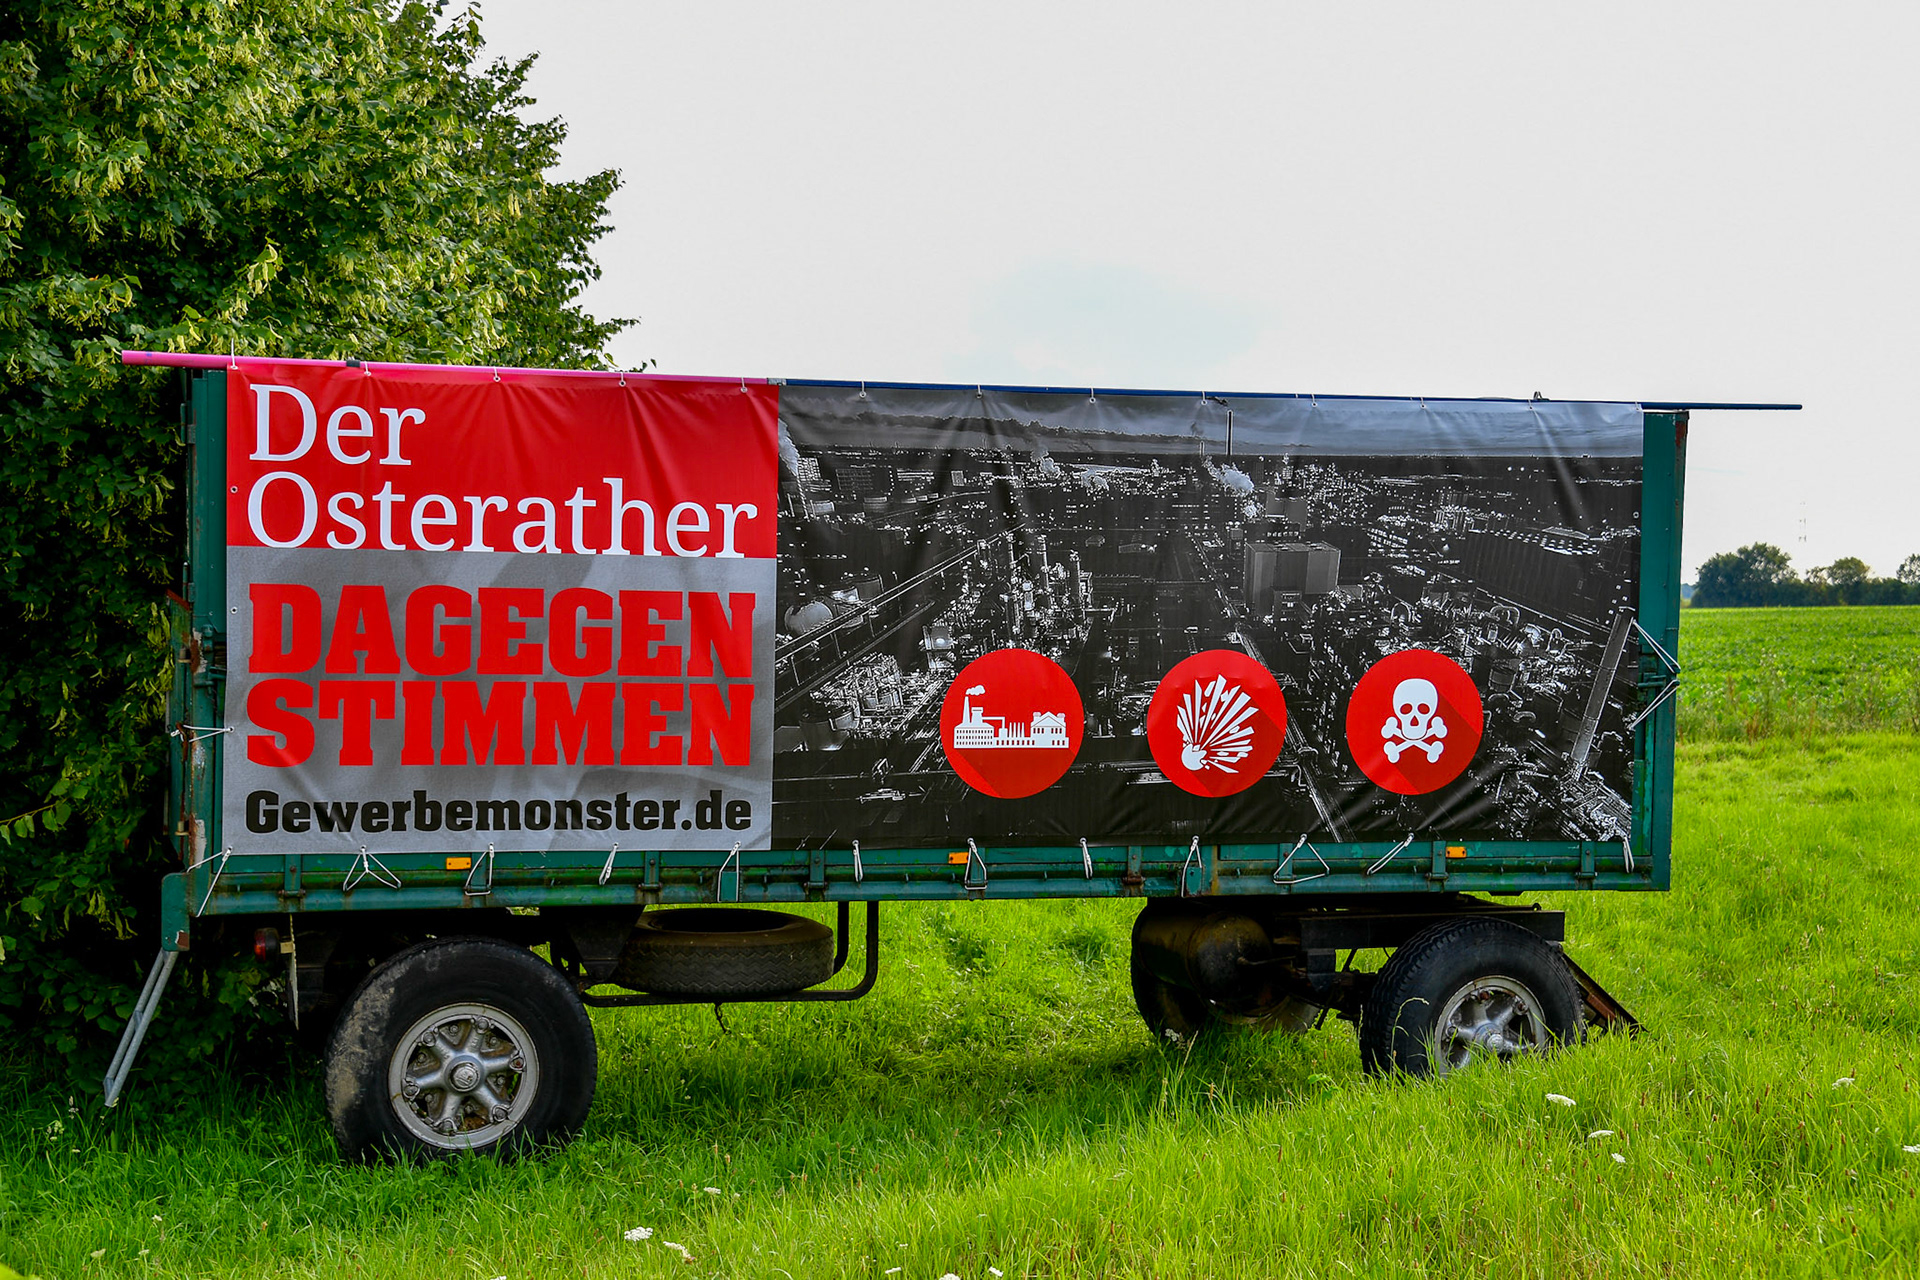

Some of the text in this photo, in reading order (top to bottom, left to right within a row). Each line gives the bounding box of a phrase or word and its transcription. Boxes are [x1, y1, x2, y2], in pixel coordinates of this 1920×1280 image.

[249, 383, 426, 466] Der
[247, 471, 758, 559] Osterather
[248, 582, 756, 678] DAGEGEN
[246, 678, 756, 768] STIMMEN
[245, 788, 752, 834] Gewerbemonster.de
